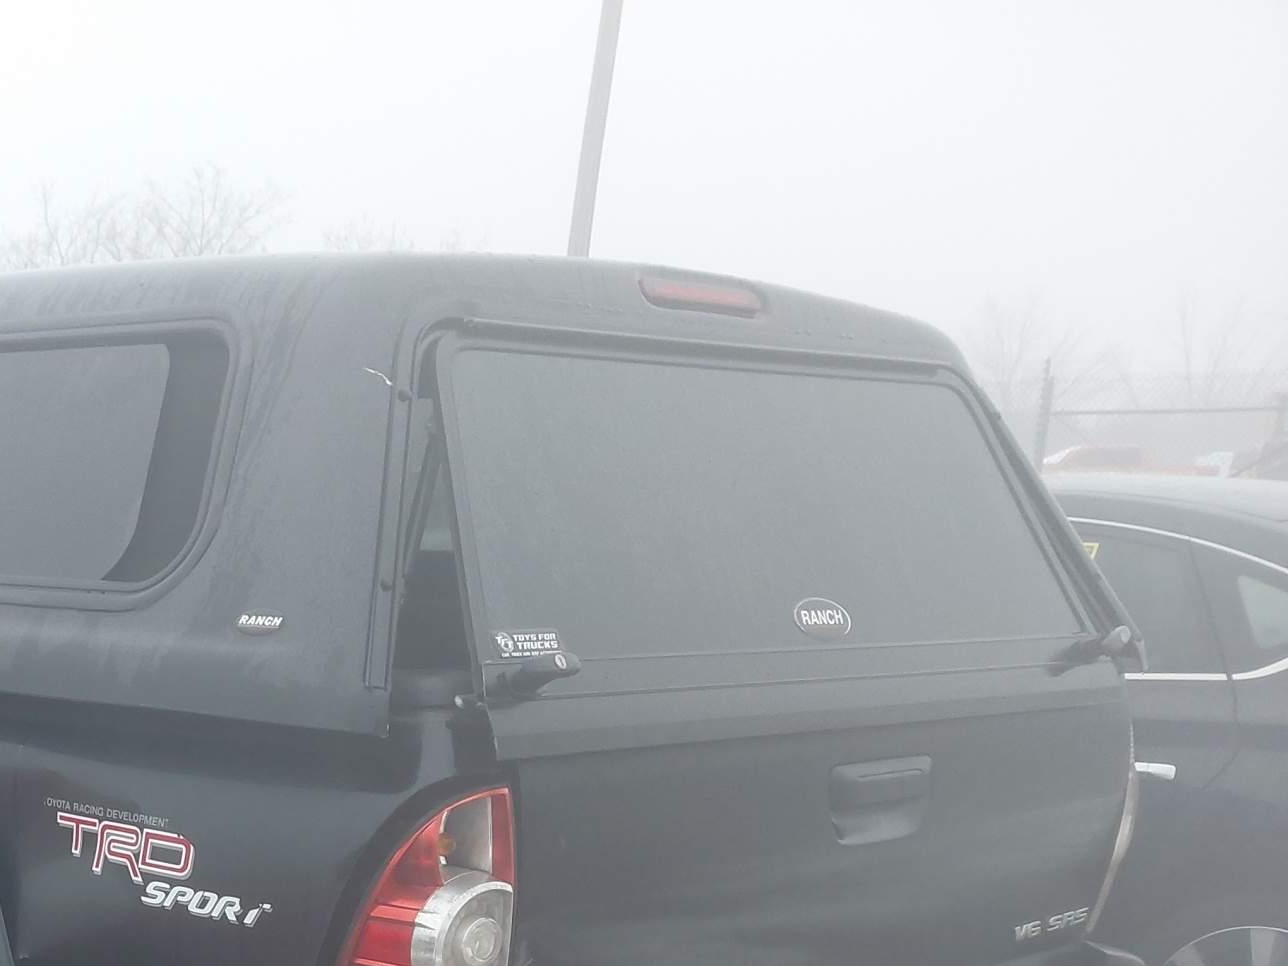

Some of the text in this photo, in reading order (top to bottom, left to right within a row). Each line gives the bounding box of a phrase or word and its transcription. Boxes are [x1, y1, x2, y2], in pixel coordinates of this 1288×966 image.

[238, 614, 283, 626] RANCH
[800, 609, 844, 625] RANCH
[513, 633, 556, 642] TOYS FOR
[517, 640, 559, 650] TRUCKS
[73, 802, 104, 817] RACING
[56, 811, 195, 885] TRD
